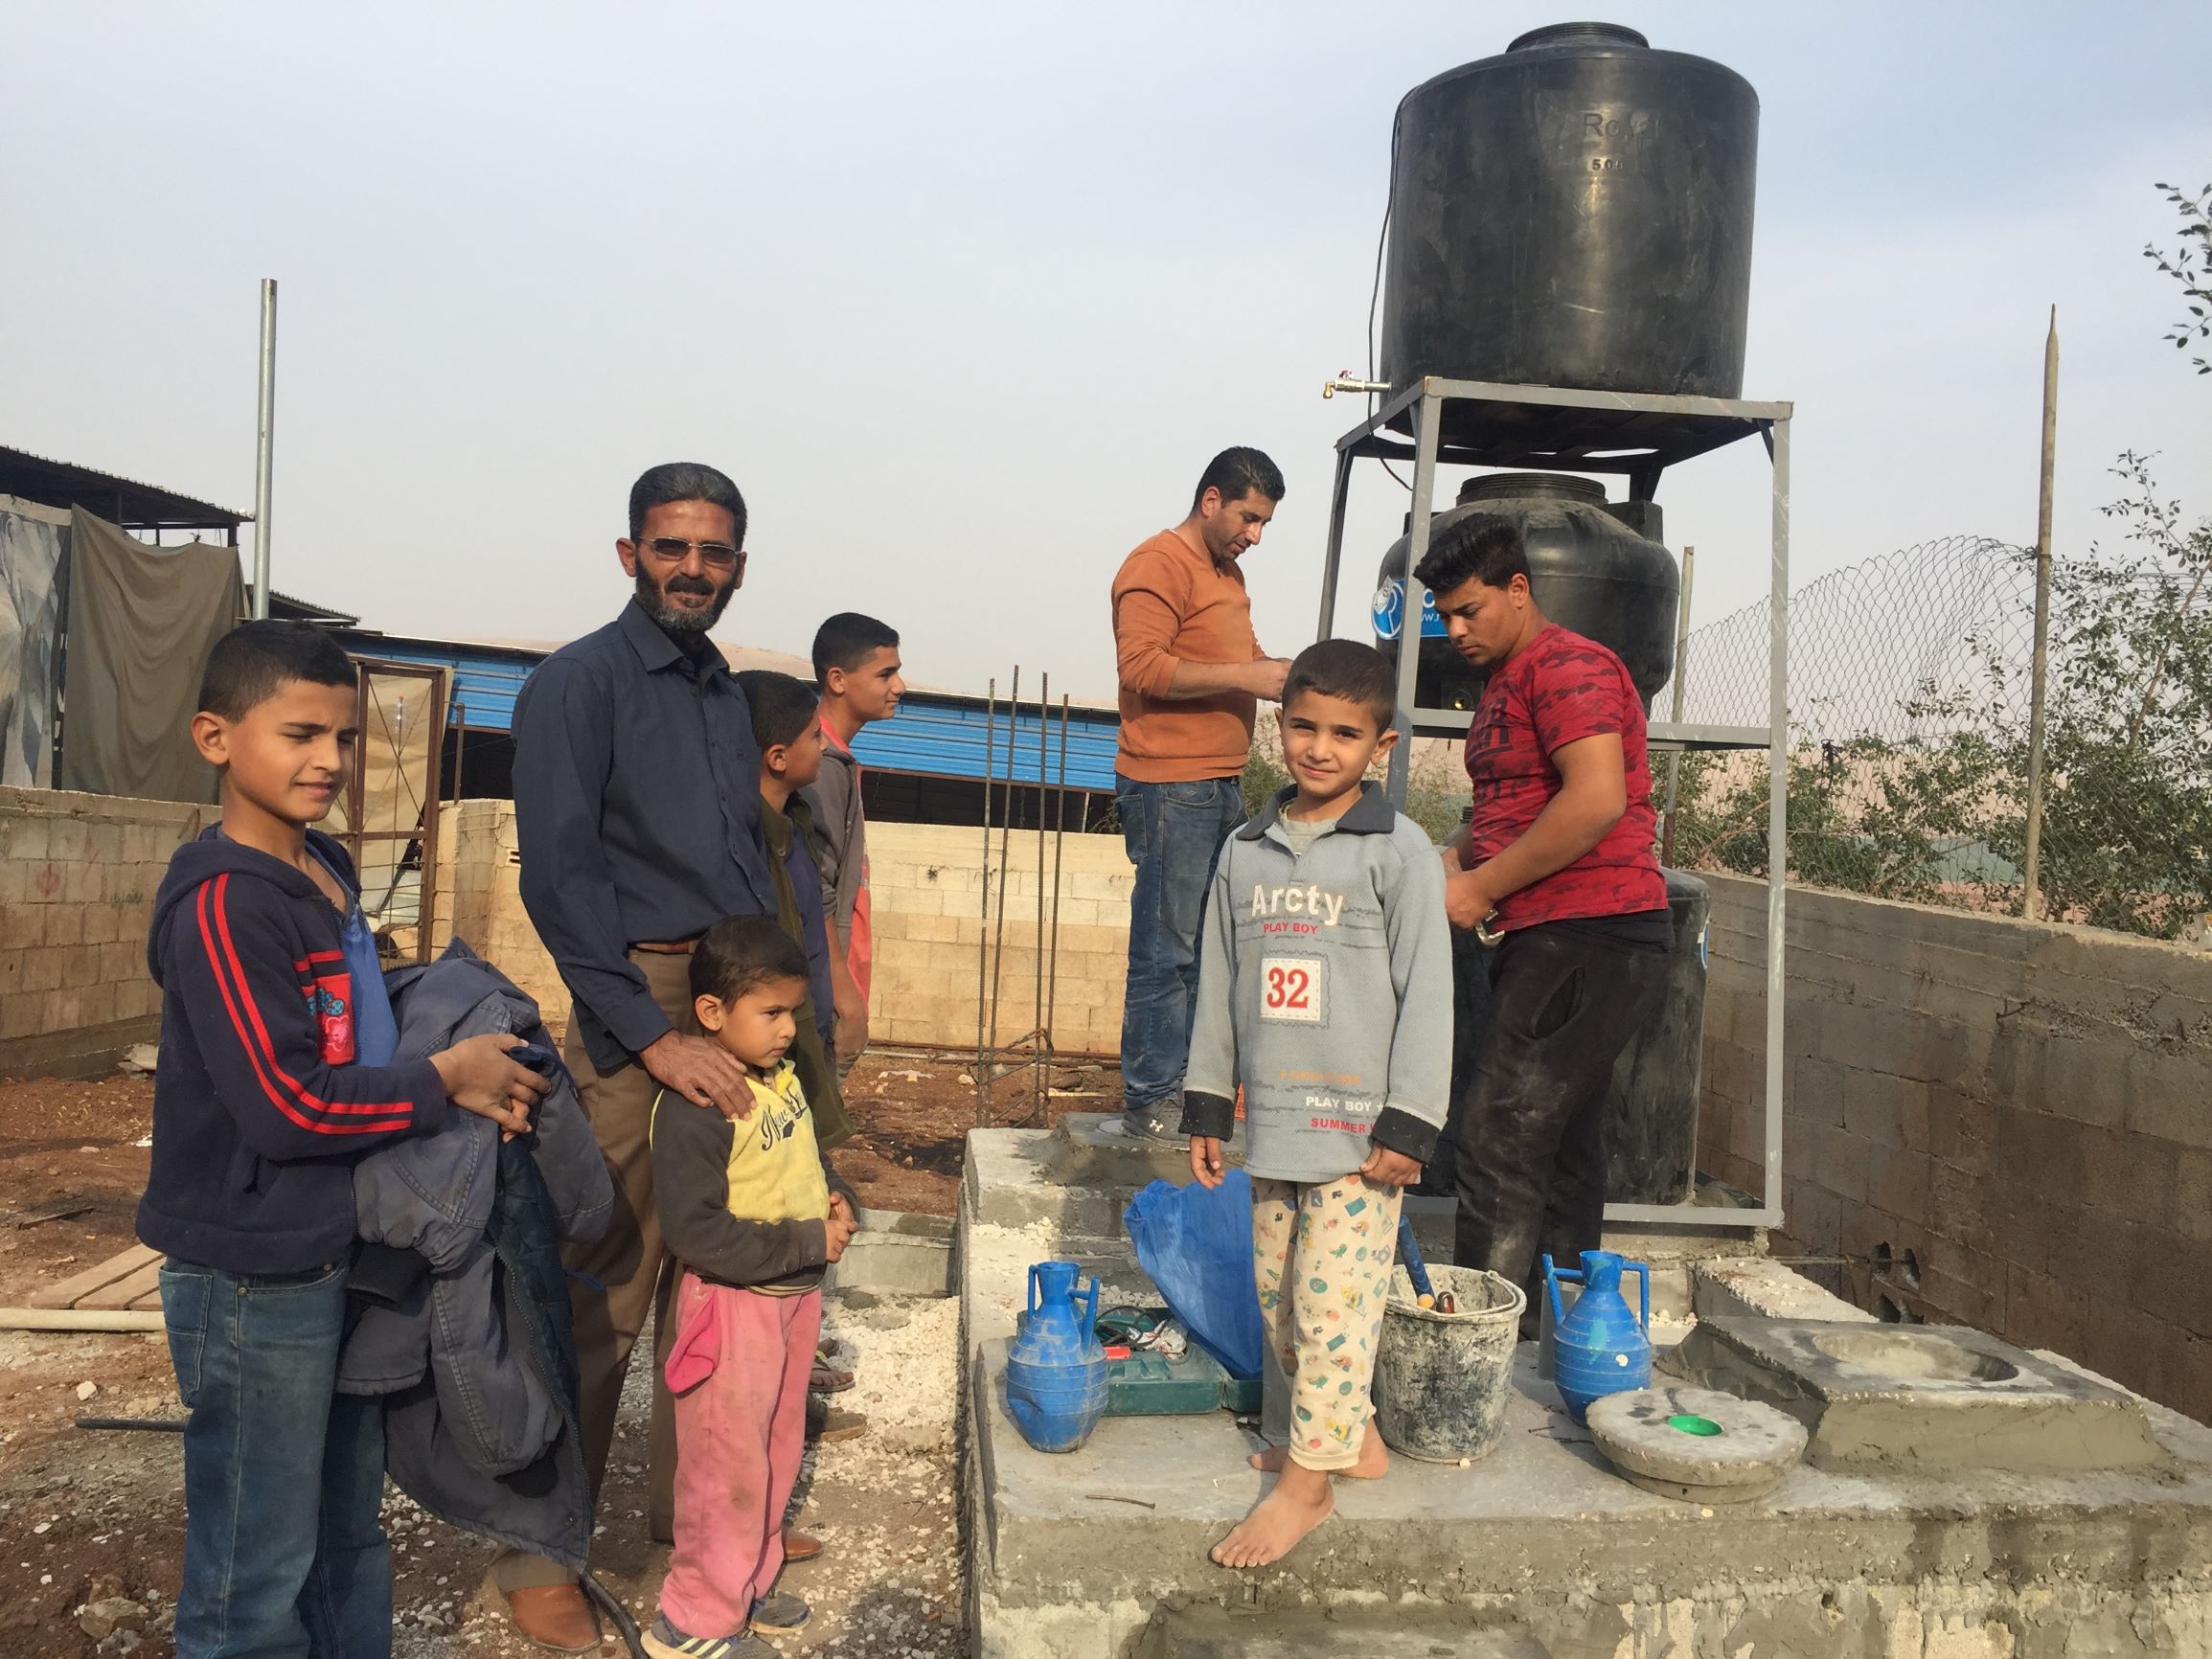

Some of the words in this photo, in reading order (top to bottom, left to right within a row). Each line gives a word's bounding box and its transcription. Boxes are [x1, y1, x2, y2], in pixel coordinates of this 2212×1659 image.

[1591, 158, 1625, 170] 500
[1251, 883, 1344, 927] Arcty
[1263, 922, 1289, 934] PLAY
[1292, 922, 1318, 935] BOY
[1266, 966, 1310, 1010] 32
[1305, 1096, 1340, 1108] PLAY
[1344, 1100, 1372, 1112] BOY
[1311, 1117, 1366, 1134] SUMMER
